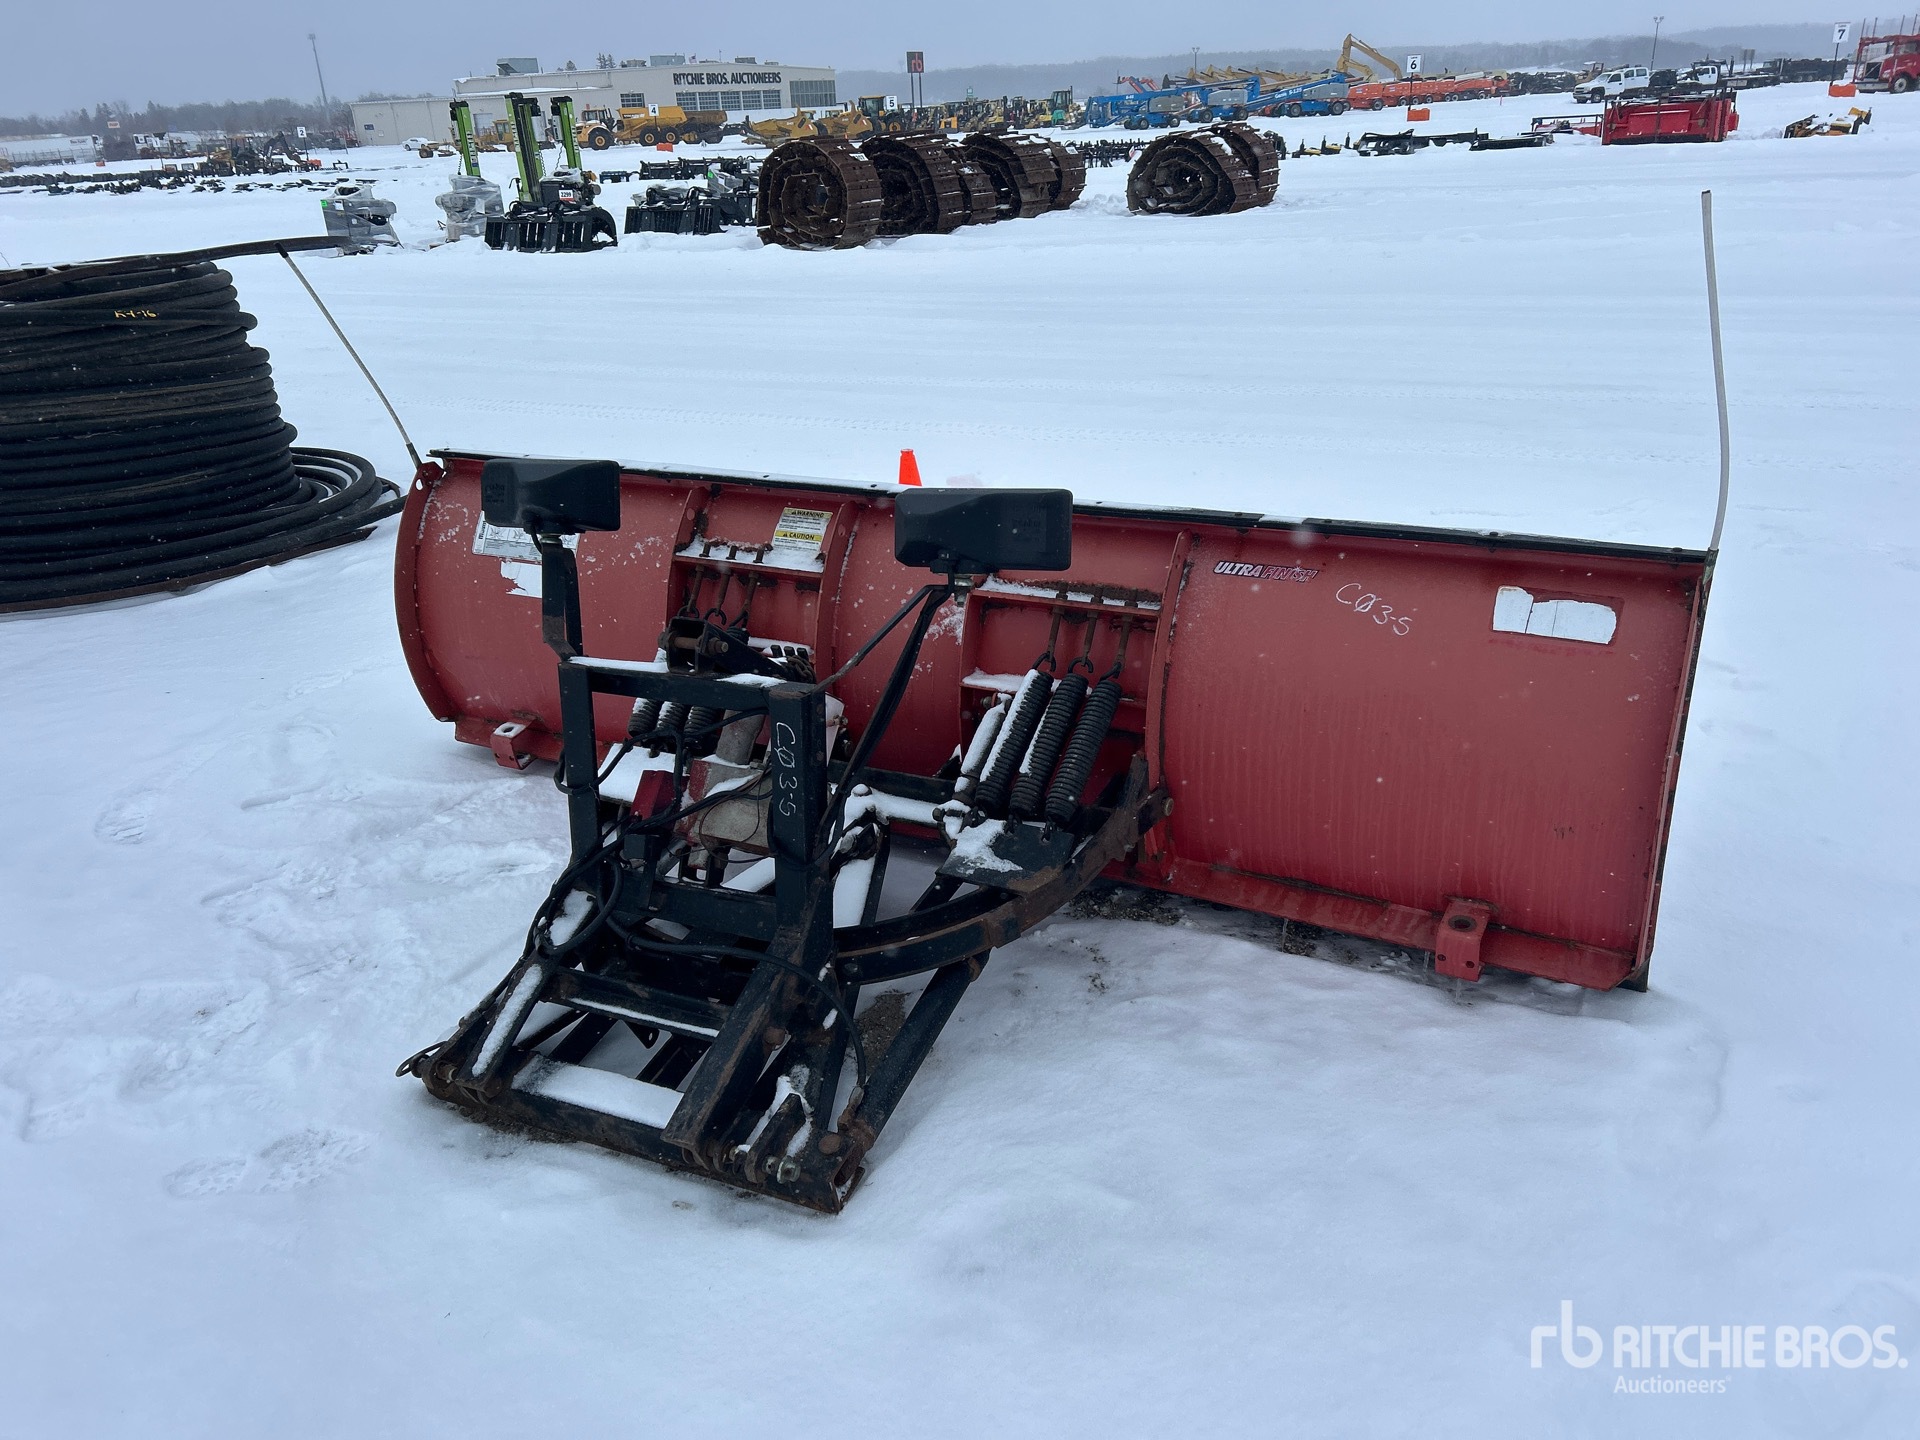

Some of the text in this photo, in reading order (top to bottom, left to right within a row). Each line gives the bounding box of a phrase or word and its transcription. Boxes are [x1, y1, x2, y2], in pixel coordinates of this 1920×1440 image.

[1838, 29, 1846, 40] 7
[911, 53, 922, 72] rb
[1410, 60, 1417, 70] 6
[673, 72, 782, 86] RITCHIE BROS. AUCTIONEERS
[889, 100, 895, 108] 5
[788, 532, 815, 540] CAUTION
